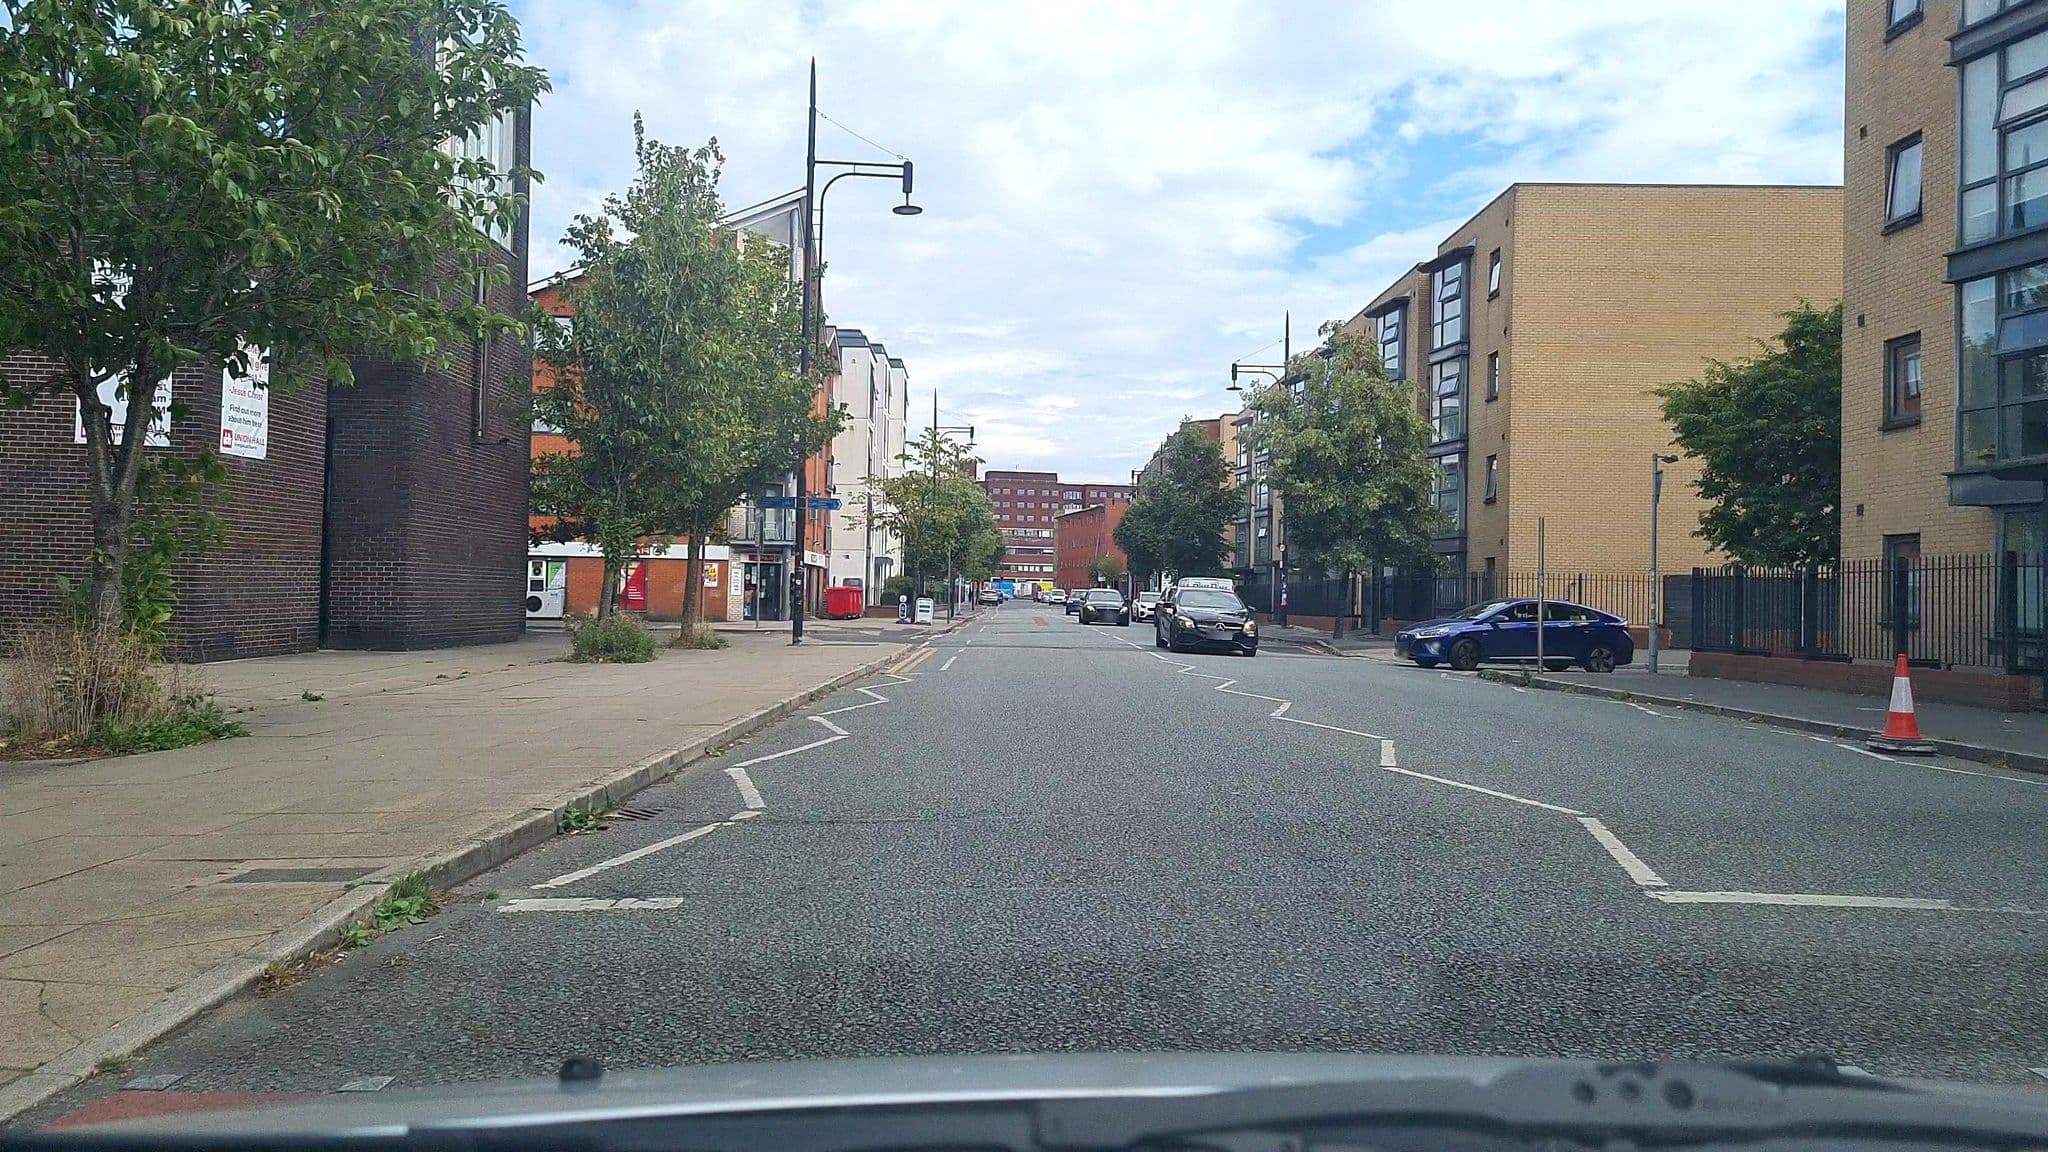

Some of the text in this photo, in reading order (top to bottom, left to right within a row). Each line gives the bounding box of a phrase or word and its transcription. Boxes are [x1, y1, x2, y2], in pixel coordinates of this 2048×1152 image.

[229, 403, 262, 418] Find out more
[228, 415, 242, 424] about
[242, 417, 252, 426] him
